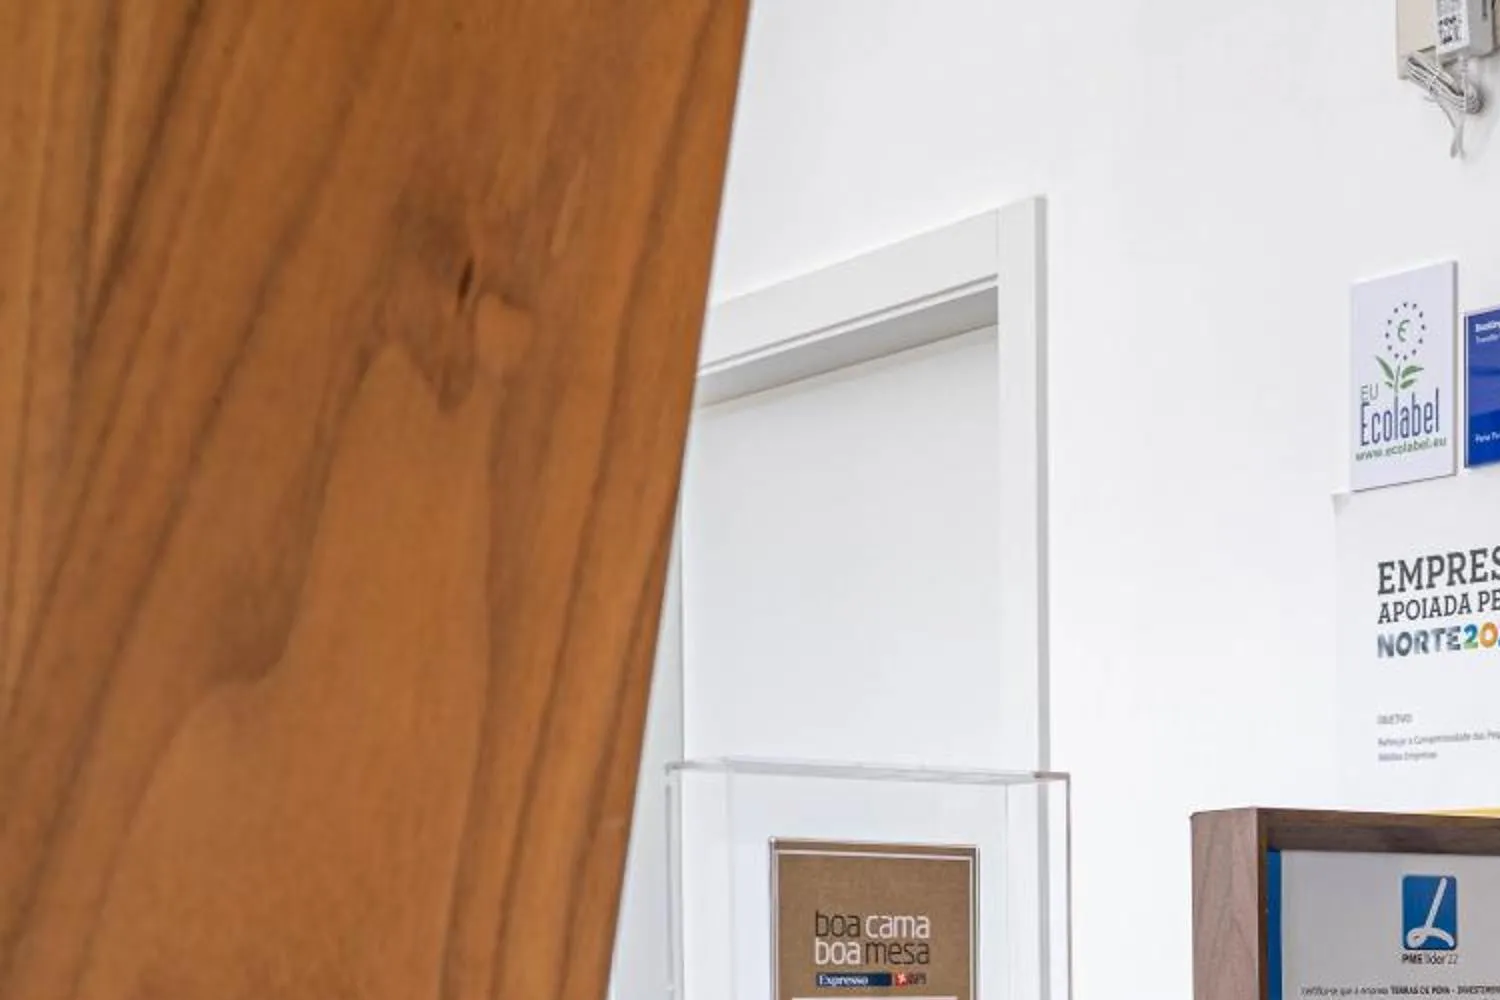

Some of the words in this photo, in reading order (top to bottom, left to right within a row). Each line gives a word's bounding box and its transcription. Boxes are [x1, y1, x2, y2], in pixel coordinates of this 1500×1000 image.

[1360, 383, 1379, 401] EU
[1360, 387, 1440, 447] Ecolabel
[1355, 436, 1447, 461] www.ecolabel.eu
[1377, 591, 1472, 625] APOIADA
[815, 909, 861, 939] boa
[865, 913, 931, 939] cama
[815, 939, 861, 965] boa
[864, 940, 931, 965] mesa
[1402, 953, 1423, 965] PME
[819, 975, 869, 987] Expresso
